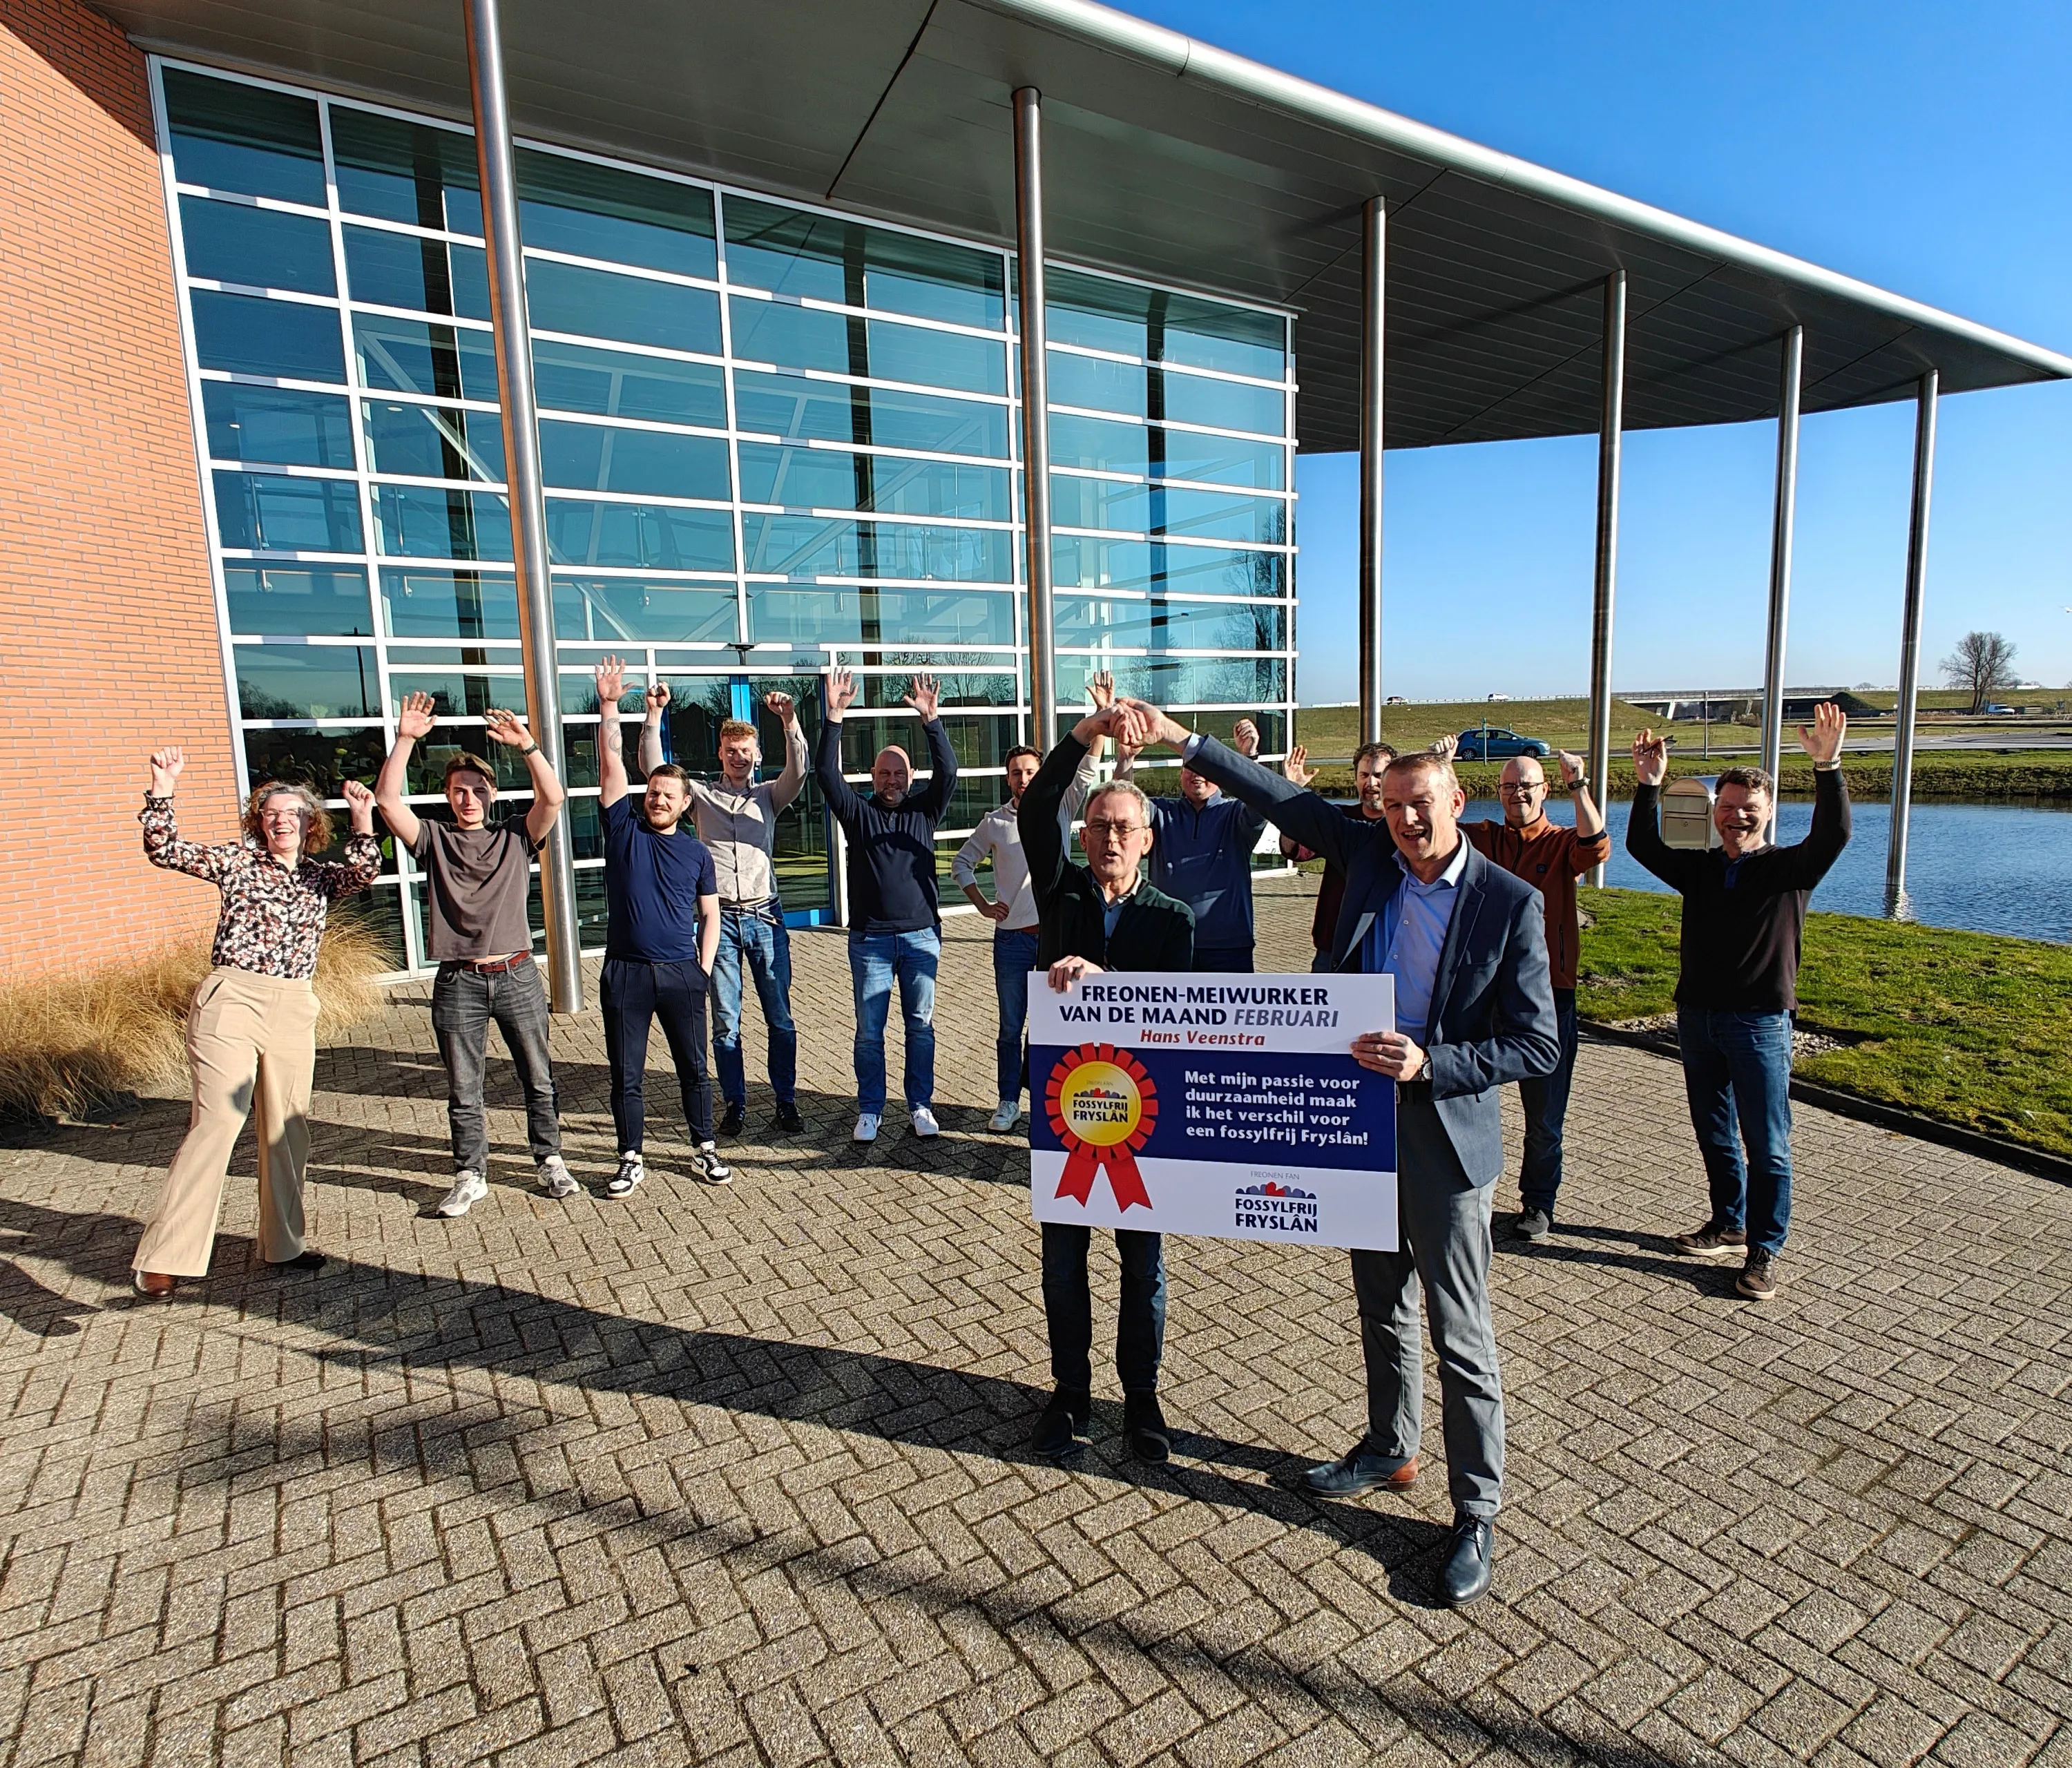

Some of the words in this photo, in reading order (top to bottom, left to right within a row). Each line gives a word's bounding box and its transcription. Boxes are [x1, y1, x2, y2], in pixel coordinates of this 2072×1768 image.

[1082, 986, 1329, 1005] FREONEN-MEIWURKER
[1059, 1006, 1101, 1022] VAN
[1109, 1007, 1135, 1024] DE
[1142, 1007, 1227, 1025] MAAND
[1234, 1009, 1339, 1027] FEBRUARI
[1140, 1029, 1180, 1044] Hans
[1187, 1030, 1265, 1046] Veenstra
[1185, 1070, 1216, 1084] Met
[1220, 1072, 1257, 1089] mijn
[1262, 1074, 1314, 1090] passie
[1319, 1079, 1360, 1089] voor
[1073, 1099, 1129, 1113] FOSSYLFRIJ
[1185, 1088, 1305, 1106] duurzaamheid
[1310, 1094, 1357, 1108] maak
[1073, 1109, 1129, 1123] FRYSLÂN
[1186, 1105, 1201, 1118] ik
[1206, 1106, 1233, 1120] het
[1238, 1110, 1304, 1124] verschil
[1310, 1115, 1350, 1126] voor
[1186, 1126, 1215, 1137] een
[1220, 1125, 1296, 1145] fossylfrij
[1301, 1129, 1368, 1146] Fryslân!
[1235, 1198, 1317, 1218] FOSSYLFRIJ
[1235, 1213, 1318, 1233] FRYSLÂN
